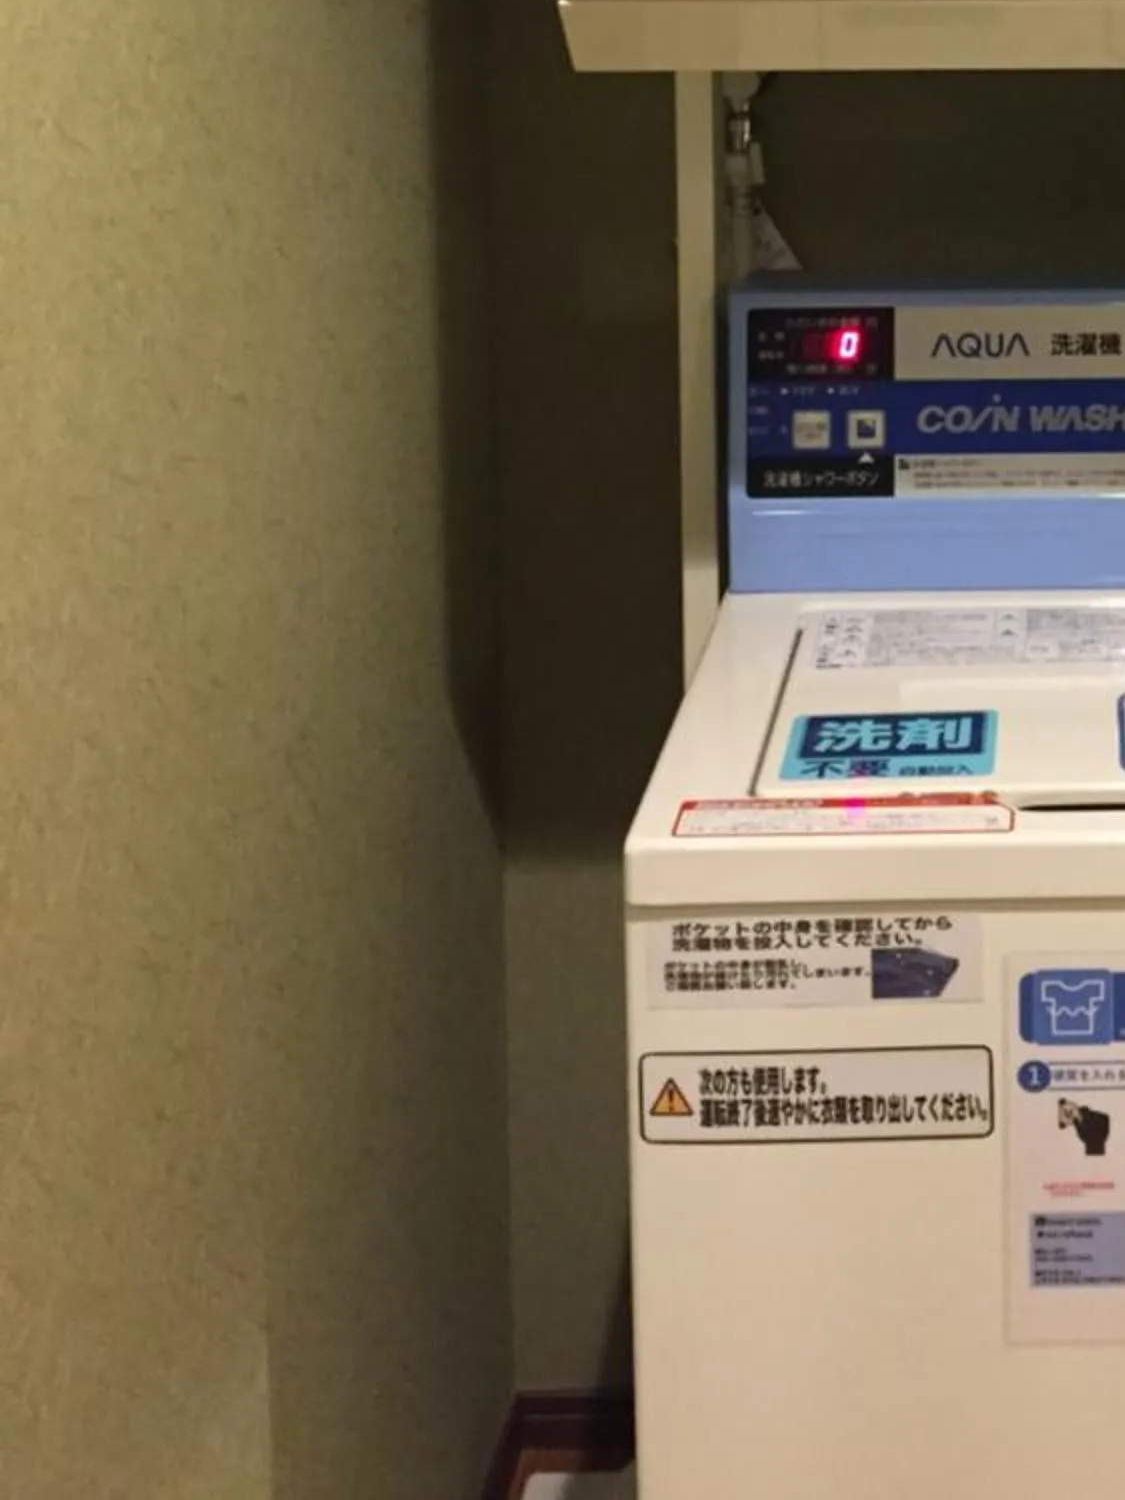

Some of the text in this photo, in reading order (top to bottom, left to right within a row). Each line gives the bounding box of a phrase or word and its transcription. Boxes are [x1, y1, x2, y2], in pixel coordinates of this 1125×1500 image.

[838, 330, 861, 359] 0
[930, 332, 1031, 358] AQUA
[1050, 332, 1122, 357] 洗濯機
[814, 717, 974, 753] 洗剤
[800, 758, 892, 778] 不要
[698, 1066, 828, 1097] 次の方も使用します。
[1028, 1066, 1041, 1086] 1
